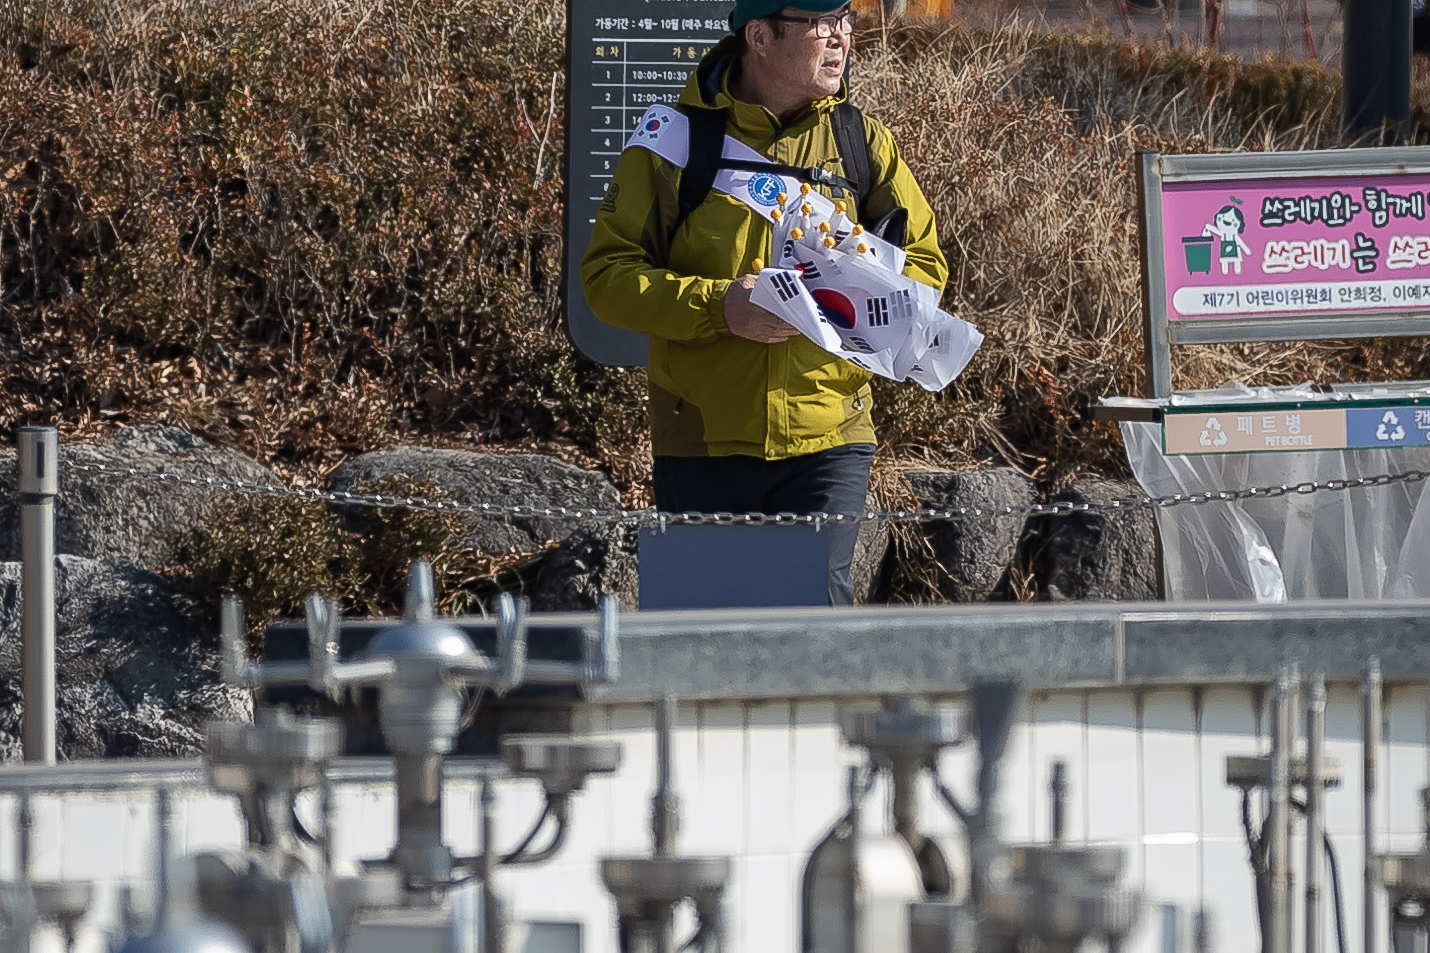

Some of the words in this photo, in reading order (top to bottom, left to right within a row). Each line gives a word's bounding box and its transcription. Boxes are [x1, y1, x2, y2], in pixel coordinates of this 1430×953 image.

[595, 18, 629, 30] 가동기간
[606, 71, 611, 80] 1
[632, 71, 688, 80] 10:00~10:30
[605, 93, 611, 102] 2
[604, 116, 611, 124] 3
[604, 138, 611, 147] 4
[604, 161, 610, 170] 5
[1263, 193, 1361, 227] 쓰레기와
[1363, 188, 1424, 227] 함께
[1202, 292, 1240, 307] 제7기
[1246, 288, 1332, 306] 어린이위원회
